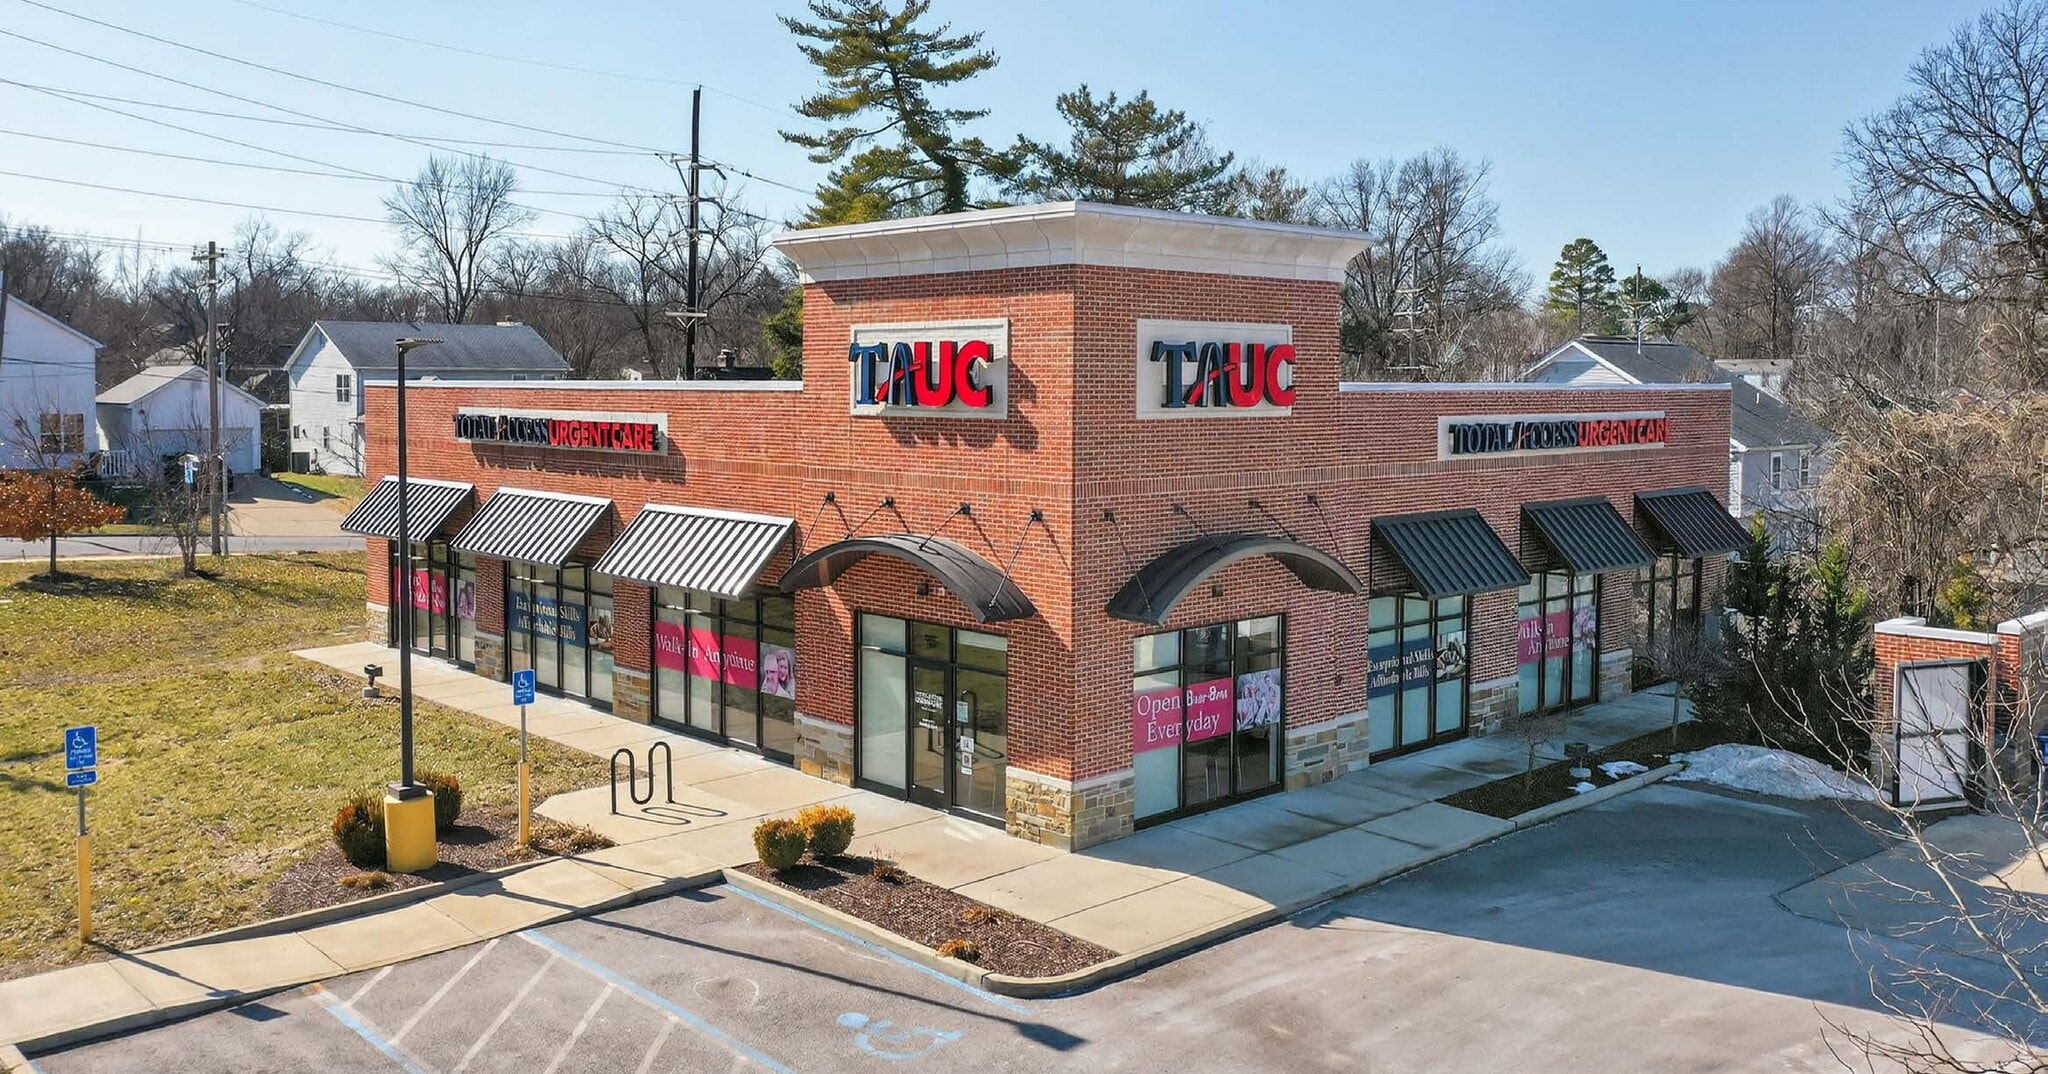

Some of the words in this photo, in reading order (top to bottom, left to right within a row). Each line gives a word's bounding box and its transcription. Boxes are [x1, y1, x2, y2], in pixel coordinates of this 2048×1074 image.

[849, 340, 994, 409] TAUC
[1151, 341, 1297, 408] TAUC
[1137, 694, 1181, 720] Open
[1146, 711, 1220, 742] Everyday
